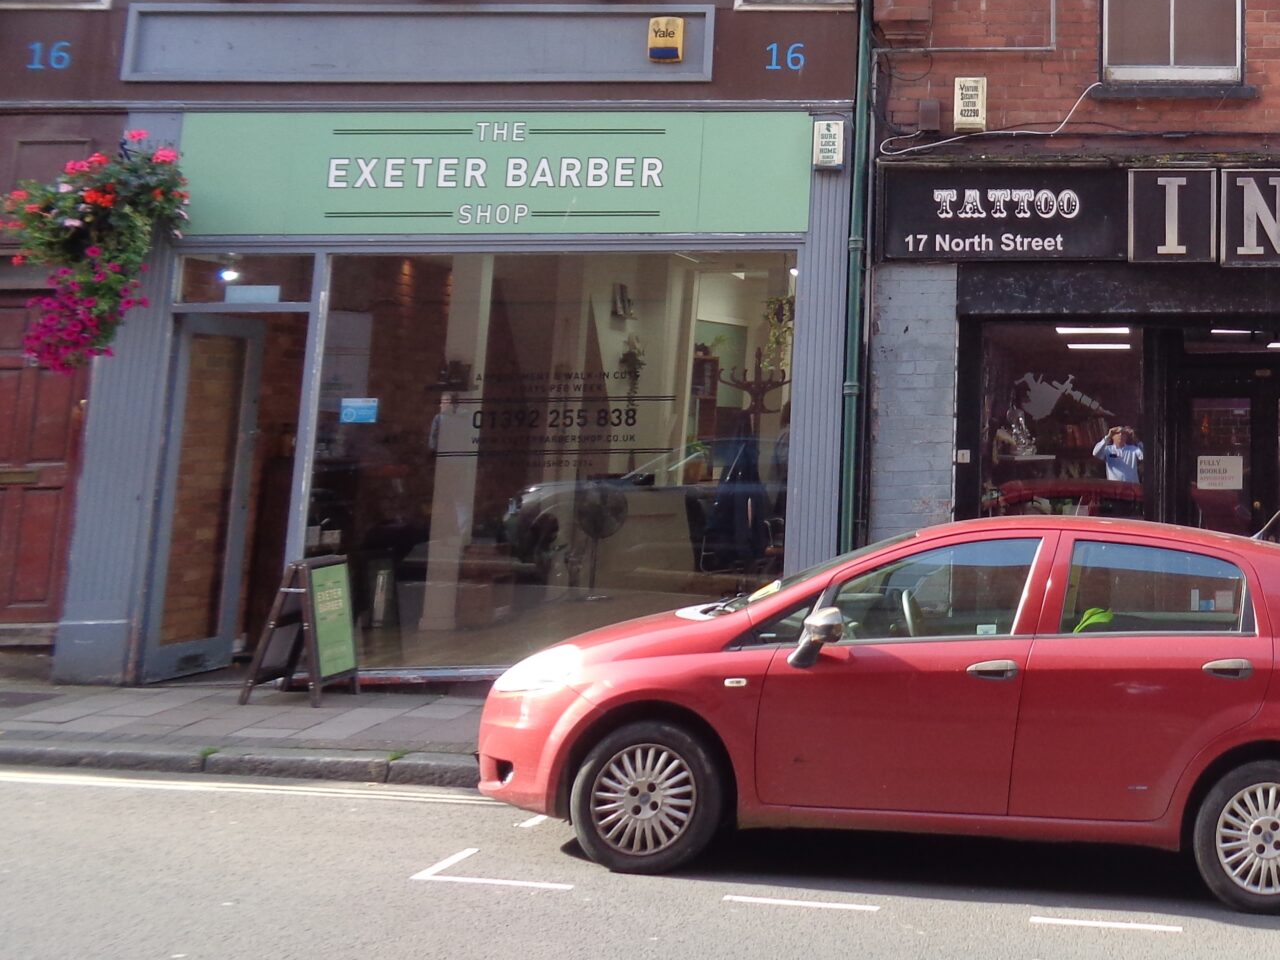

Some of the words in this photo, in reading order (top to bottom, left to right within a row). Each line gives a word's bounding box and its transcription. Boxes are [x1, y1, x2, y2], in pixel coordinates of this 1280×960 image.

[653, 28, 676, 38] Yale
[26, 41, 72, 71] 16
[765, 42, 806, 71] 16
[475, 122, 527, 142] THE
[326, 157, 488, 189] EXETER
[504, 157, 664, 188] BARBER
[933, 189, 1080, 218] TATTOO
[458, 204, 529, 224] SHOP
[904, 234, 928, 251] 17
[934, 234, 993, 251] North
[1000, 233, 1063, 251] Street
[472, 409, 540, 429] 01392
[548, 408, 588, 428] 255
[596, 407, 638, 427] 838
[1200, 458, 1221, 466] FULLY
[1200, 467, 1228, 475] BOOKED
